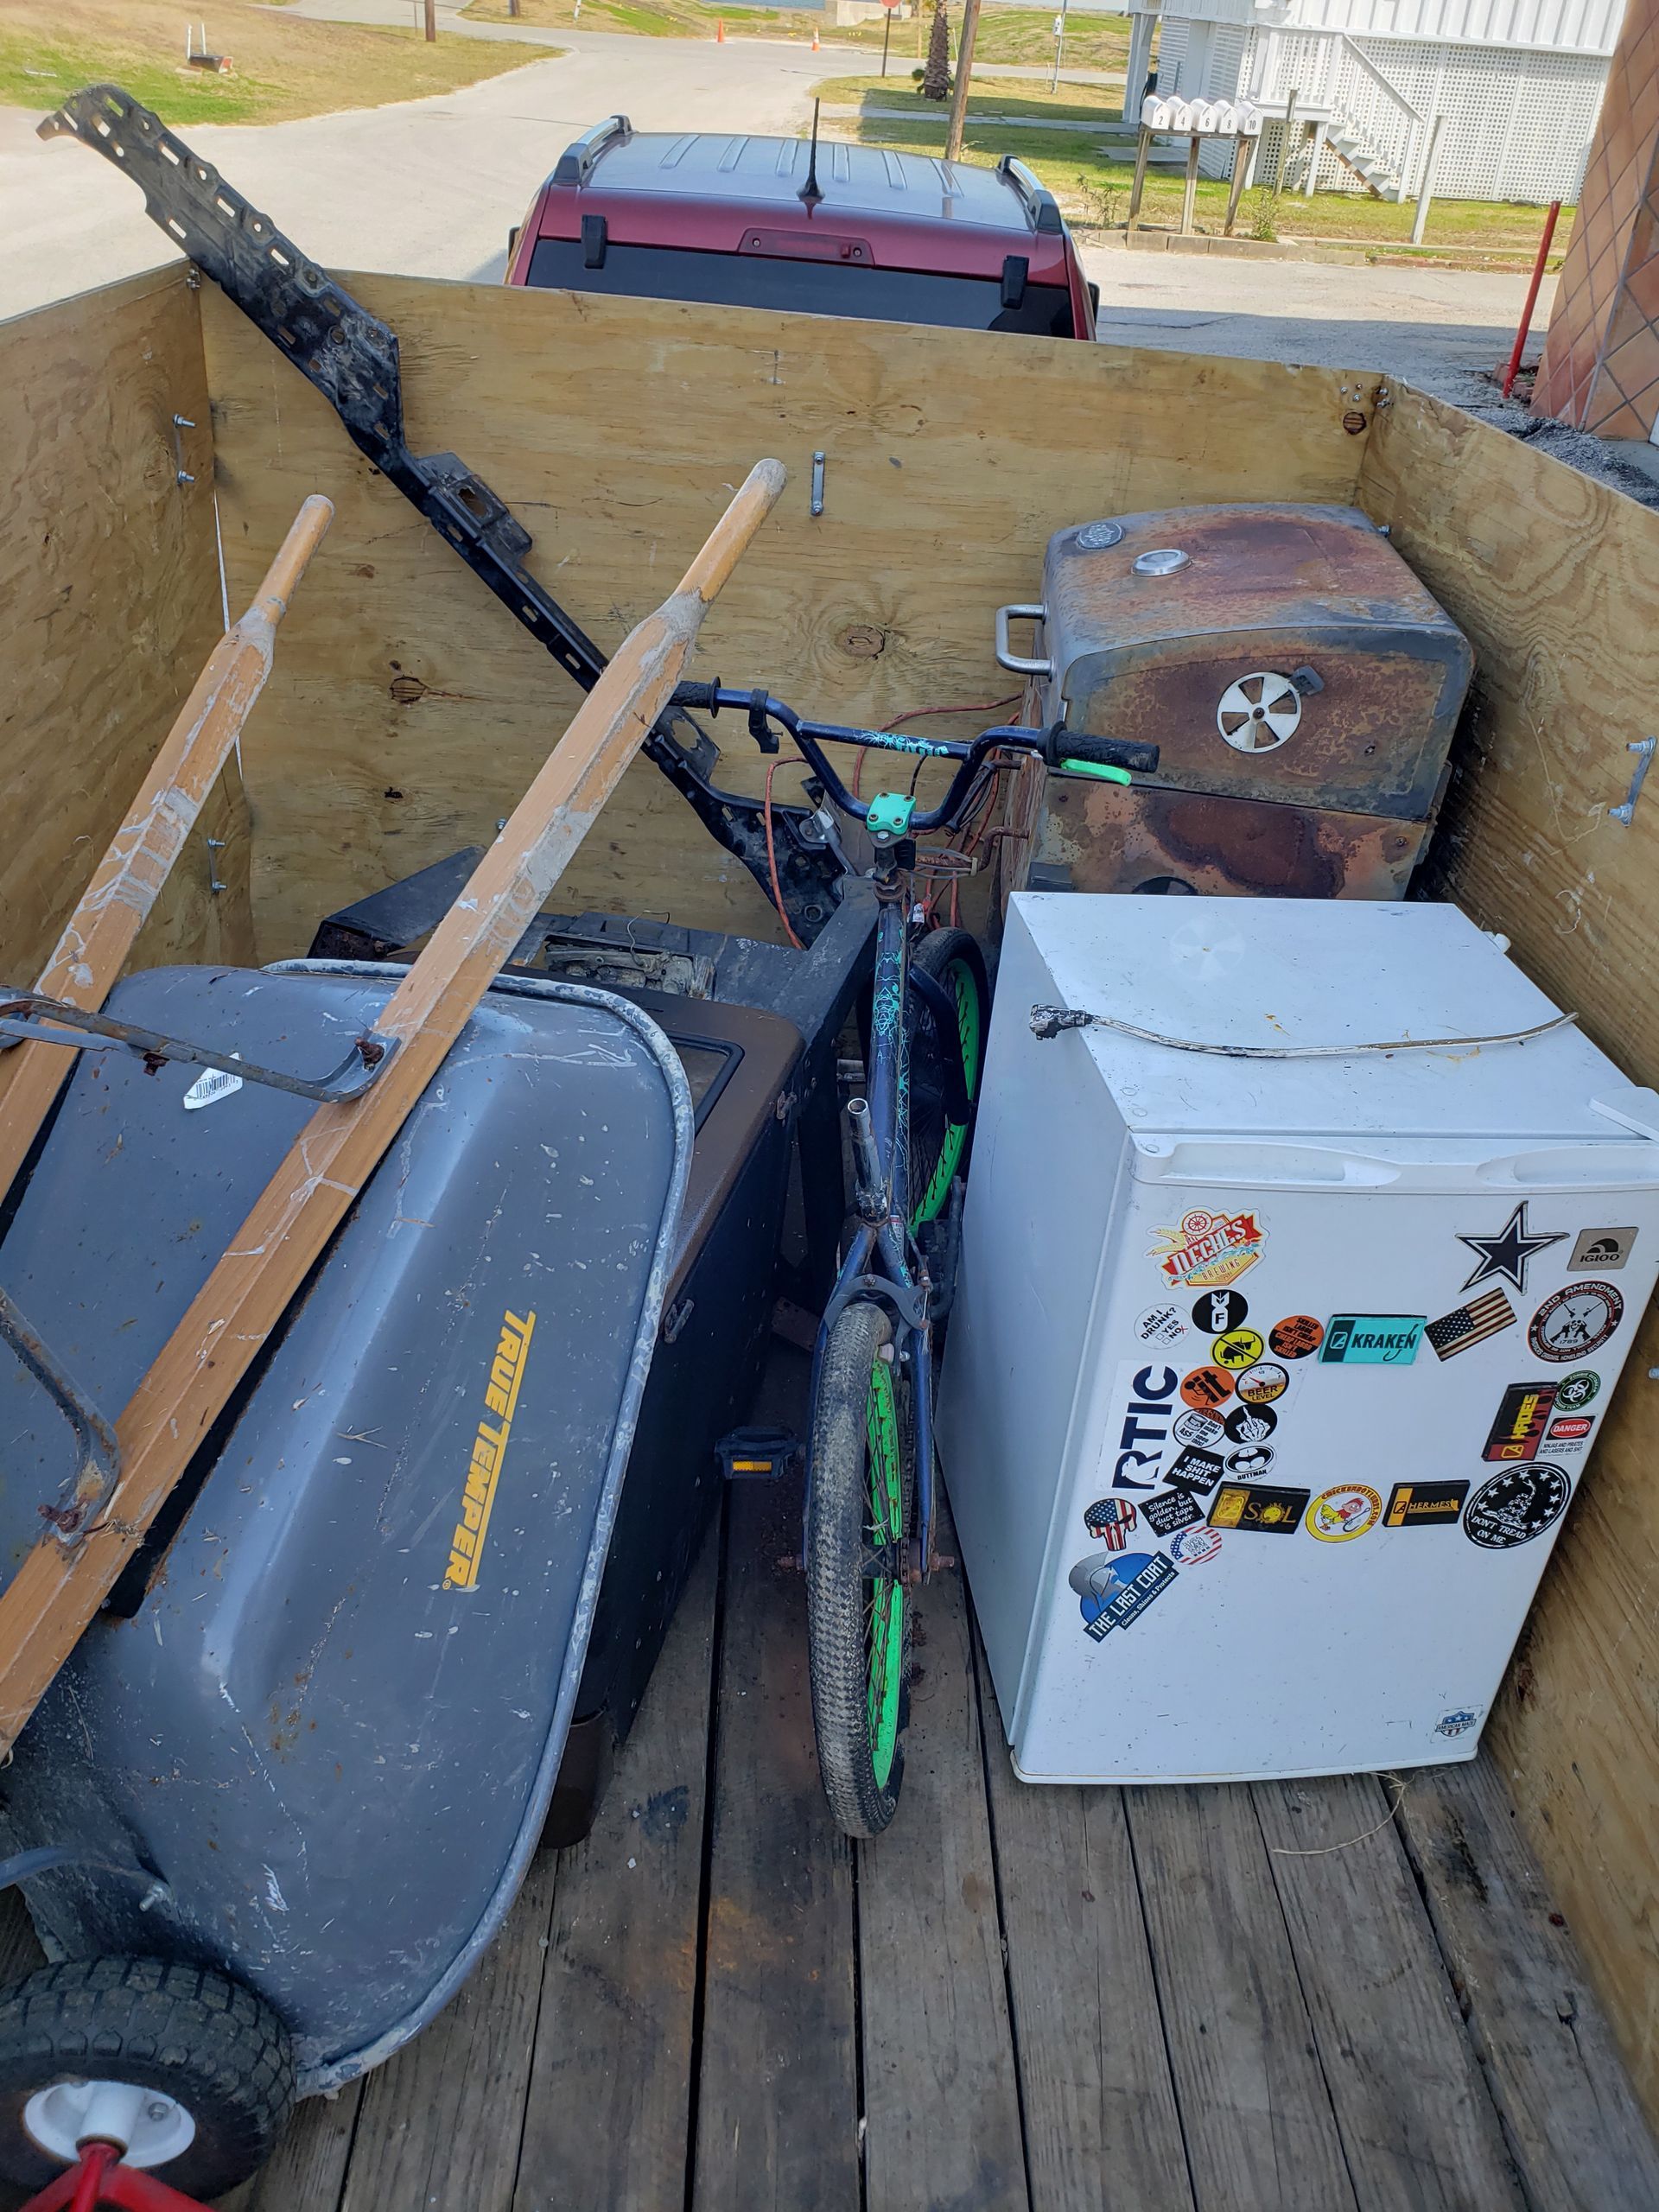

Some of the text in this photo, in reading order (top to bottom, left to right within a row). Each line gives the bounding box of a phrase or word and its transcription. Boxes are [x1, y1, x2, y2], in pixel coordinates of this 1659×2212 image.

[1158, 115, 1164, 125] 2
[1180, 117, 1185, 126] 4
[1205, 118, 1211, 127] 6
[1226, 119, 1231, 129] 8
[1249, 119, 1256, 130] 10
[1201, 1258, 1241, 1281] BREWING
[1565, 1283, 1622, 1310] AMENDMENT
[1141, 1306, 1177, 1340] DRUNK?
[1142, 1313, 1158, 1328] AM
[1215, 1313, 1224, 1325] F
[1296, 1317, 1319, 1331] SKILLED
[1161, 1319, 1179, 1334] YES
[1168, 1326, 1182, 1339] NO
[1274, 1332, 1296, 1344] CHEAP
[1296, 1332, 1317, 1341] CHEAP
[1351, 1332, 1418, 1350] KRAKEN
[1274, 1344, 1298, 1358] SKILLED
[1248, 1385, 1278, 1396] BEER
[1510, 1394, 1540, 1440] HADES
[1111, 1364, 1179, 1491] RTIC
[1179, 1427, 1194, 1437] ASS
[1553, 1423, 1588, 1433] DANGER
[445, 1309, 537, 1588] TRUE TEMPER
[1185, 1464, 1211, 1478] SHIT
[1191, 1457, 1222, 1473] MAKE
[1172, 1467, 1215, 1486] HAPPEN
[1237, 1469, 1268, 1481] BUTTMAN
[1148, 1497, 1176, 1512] Silence
[1148, 1497, 1192, 1522] golden, but
[1408, 1501, 1451, 1510] HERMES
[1156, 1505, 1194, 1526] duct tape
[1164, 1522, 1172, 1530] is
[1498, 1524, 1527, 1540] TREAD
[1477, 1529, 1507, 1544] ON ME
[1089, 1556, 1168, 1637] THE LAST COAT
[1121, 1608, 1140, 1626] Cleans,
[1136, 1593, 1155, 1611] Shines
[1155, 1571, 1176, 1592] Protects
